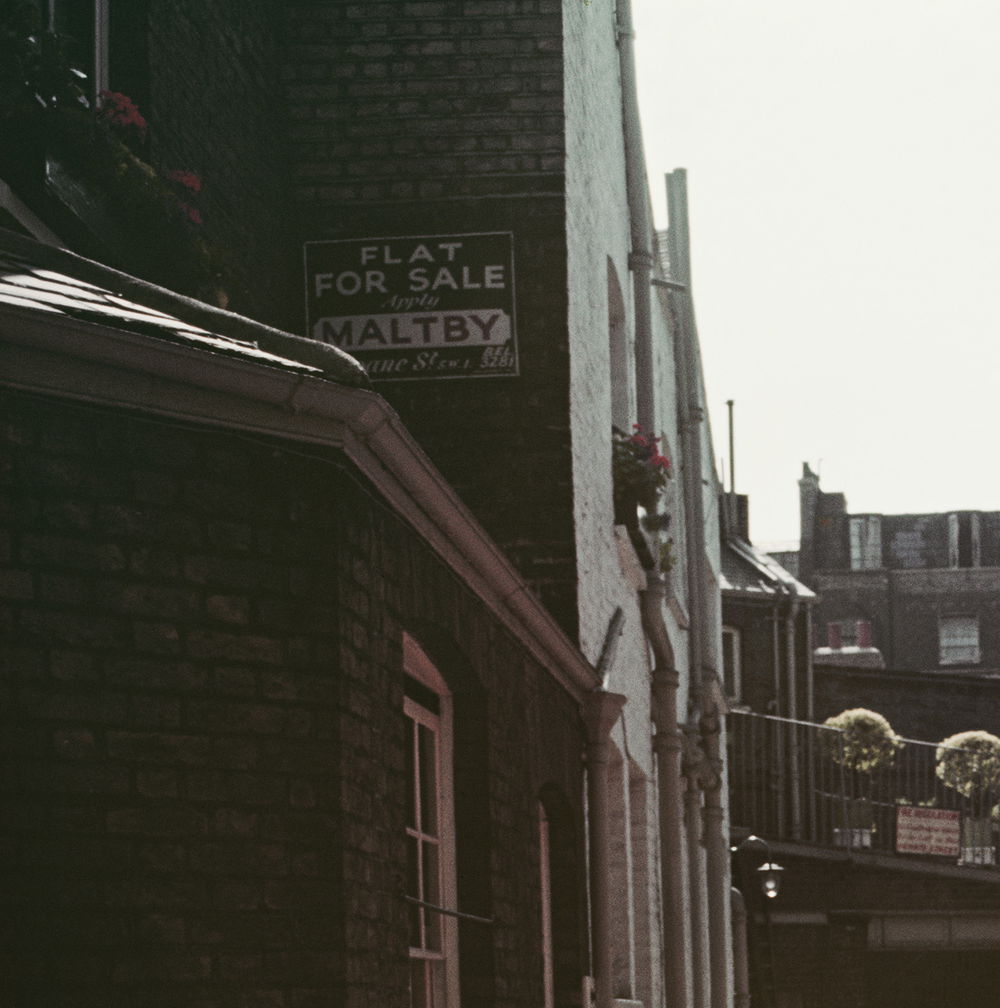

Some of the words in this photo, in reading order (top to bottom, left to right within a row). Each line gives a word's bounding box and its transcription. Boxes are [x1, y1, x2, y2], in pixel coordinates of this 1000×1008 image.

[360, 242, 463, 266] FLAT
[314, 270, 388, 298] FOR
[408, 265, 506, 292] SALE
[381, 293, 440, 312] Apply
[321, 313, 500, 347] MALTBY
